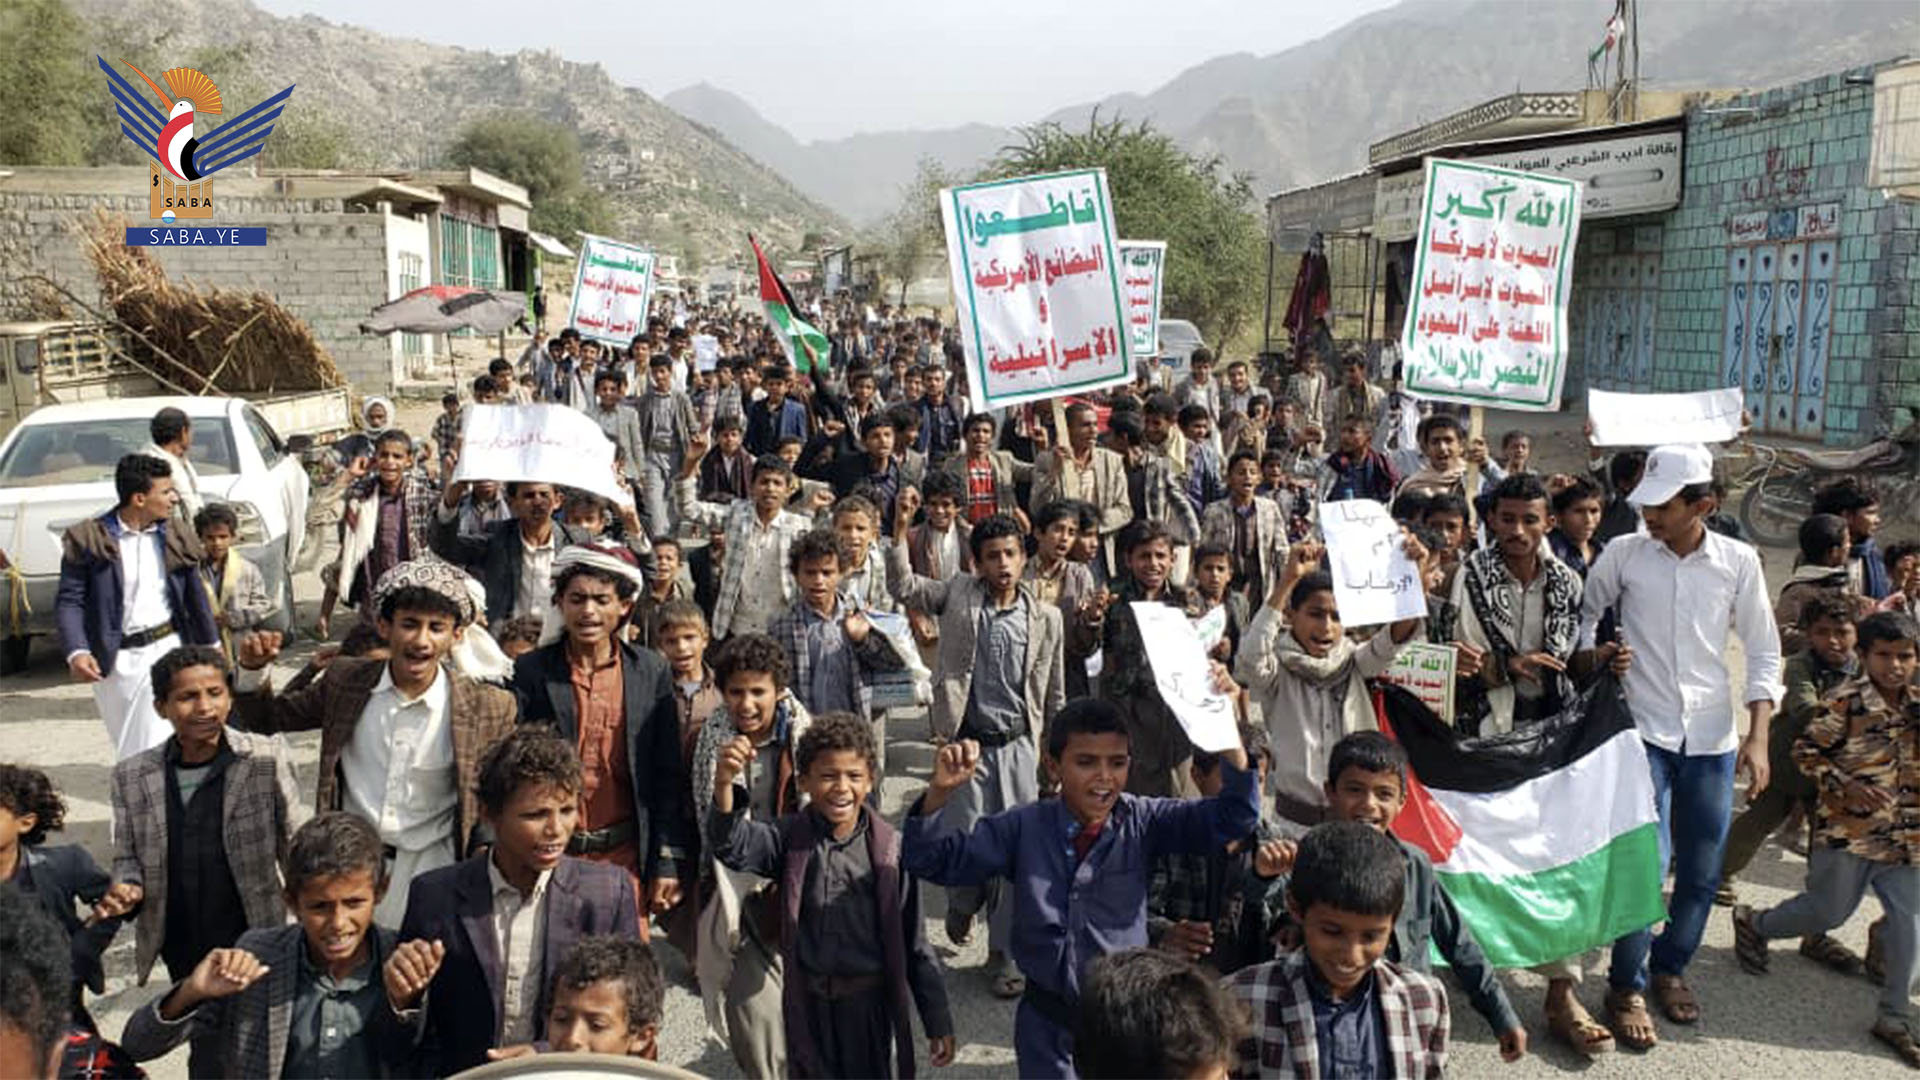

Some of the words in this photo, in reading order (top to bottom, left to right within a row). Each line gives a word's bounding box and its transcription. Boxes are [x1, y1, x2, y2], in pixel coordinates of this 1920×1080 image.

[964, 189, 1097, 247] قاطعوا
[1434, 180, 1518, 226] أكبر
[1516, 190, 1566, 228] الله
[973, 249, 1041, 294] الأمريكية
[1045, 245, 1104, 285] البضائع
[1503, 243, 1558, 269] الموت
[1039, 296, 1048, 323] و
[1498, 279, 1552, 308] الموت
[1418, 311, 1467, 340] اليهود
[1472, 315, 1500, 343] على
[1508, 315, 1551, 344] اللعنة
[989, 327, 1117, 379] الإسرائيلية
[1490, 351, 1549, 390] النصر
